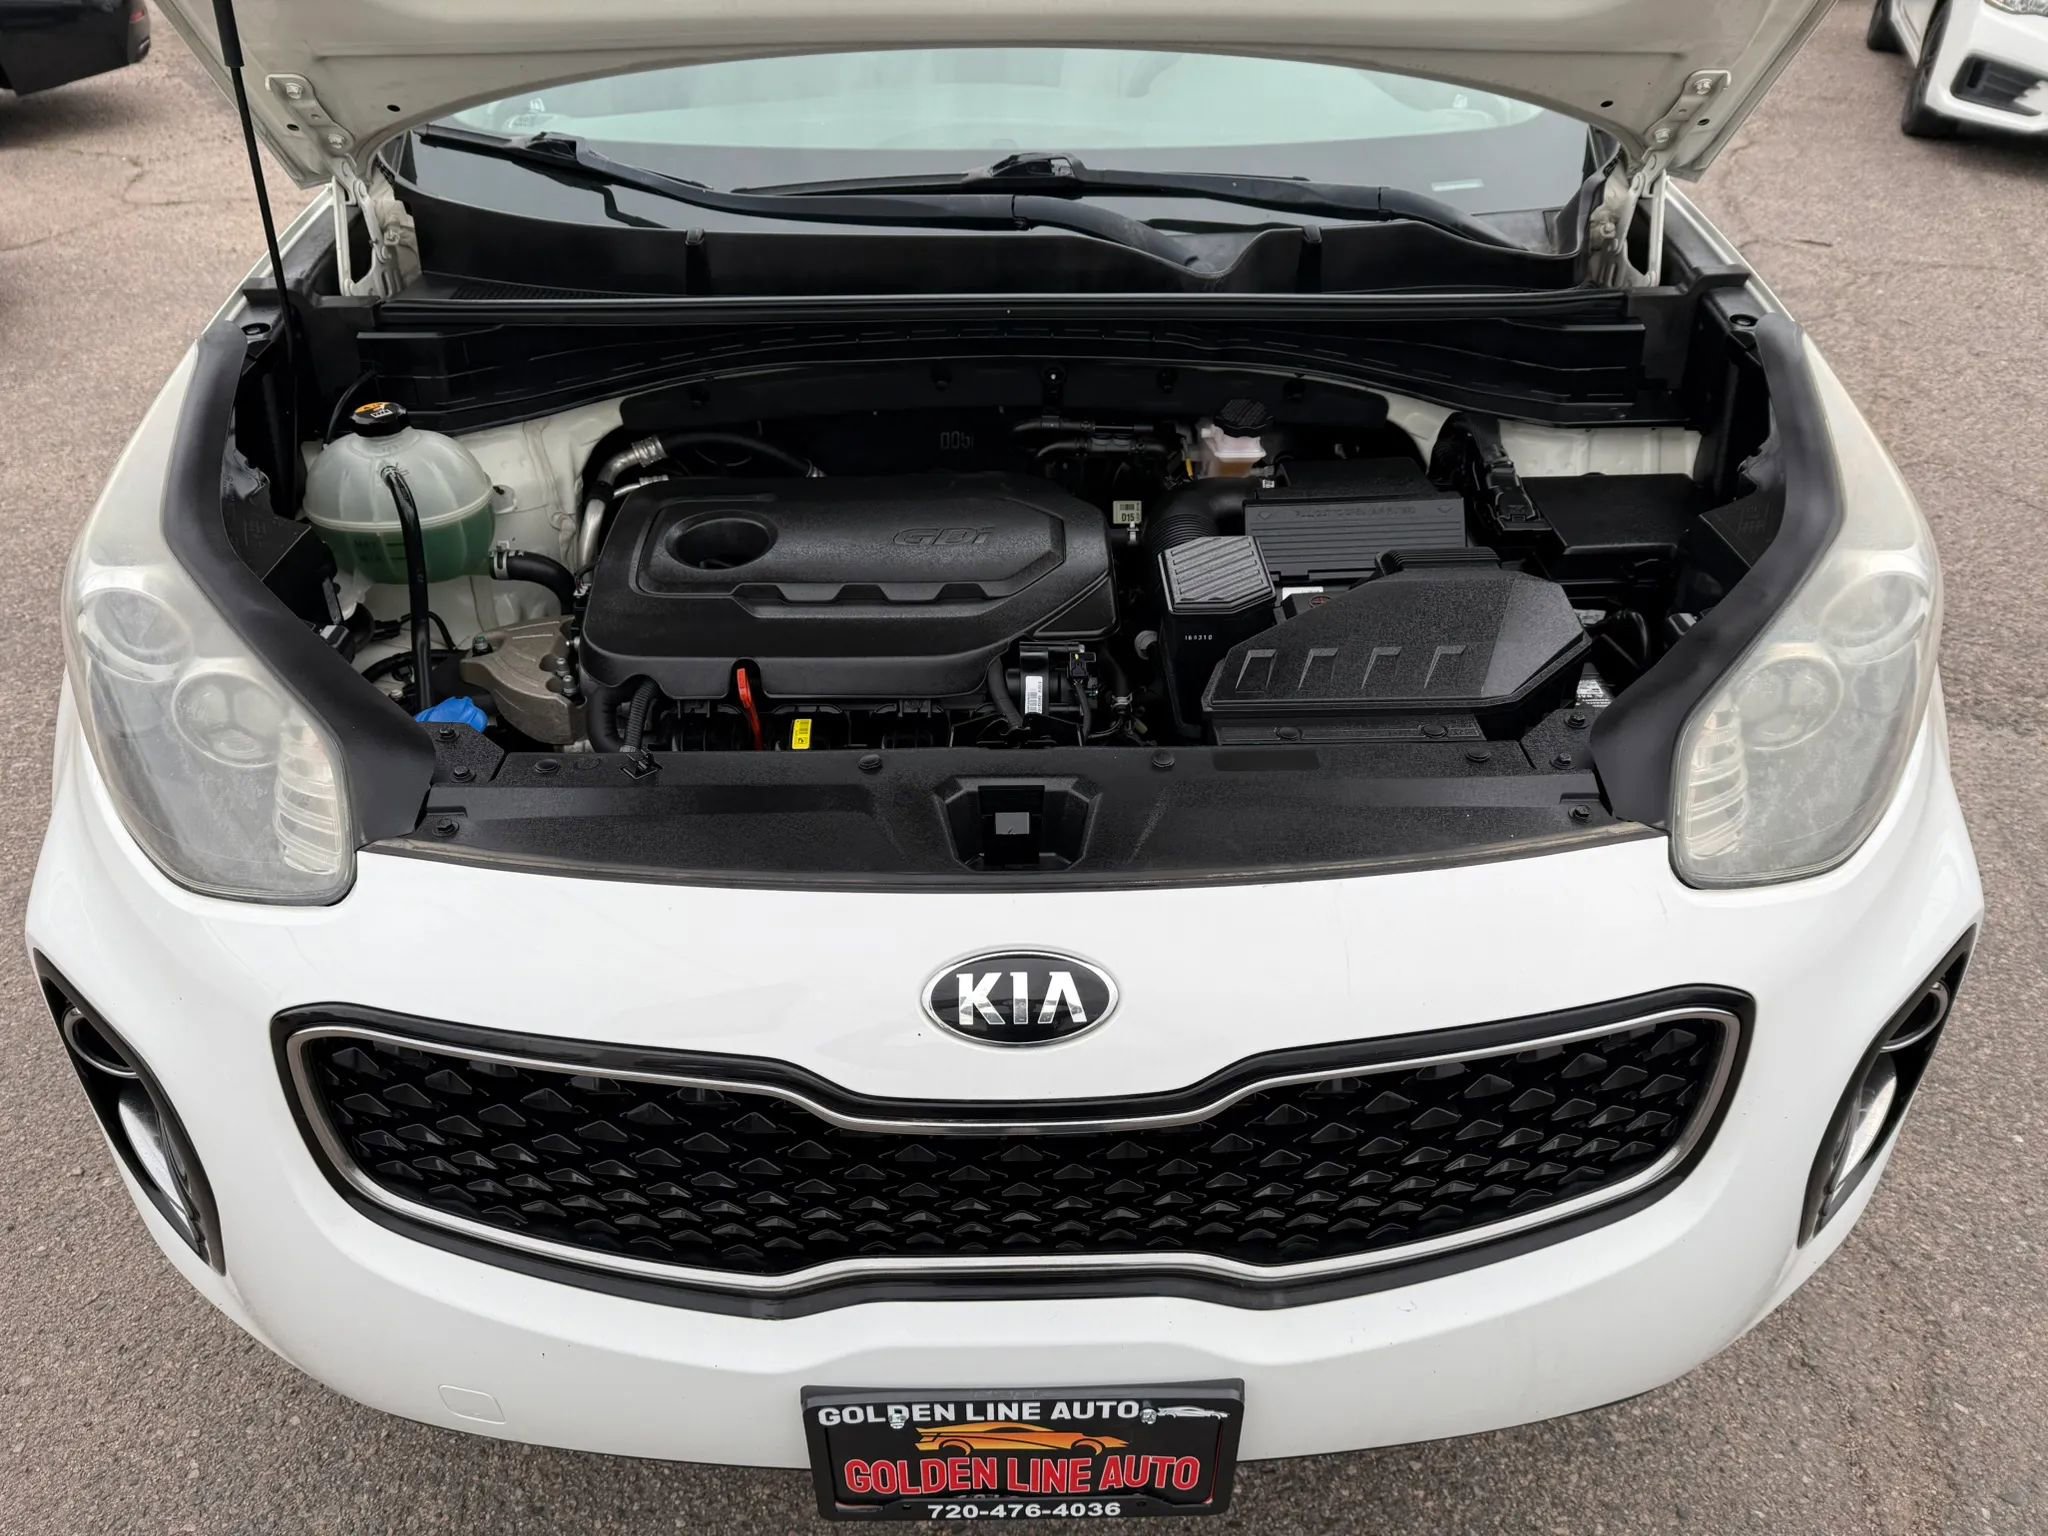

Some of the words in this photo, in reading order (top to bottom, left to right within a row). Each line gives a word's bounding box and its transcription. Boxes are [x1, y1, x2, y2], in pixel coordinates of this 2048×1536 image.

[956, 971, 1088, 1025] KIA
[818, 1403, 956, 1426] GOLDEN
[966, 1402, 1041, 1421] LINE
[1050, 1400, 1140, 1420] AUTO
[844, 1457, 998, 1495] GOLDEN
[1007, 1457, 1092, 1494] LINE
[1099, 1455, 1200, 1491] AUTO
[927, 1502, 1121, 1519] 720-476-4036
